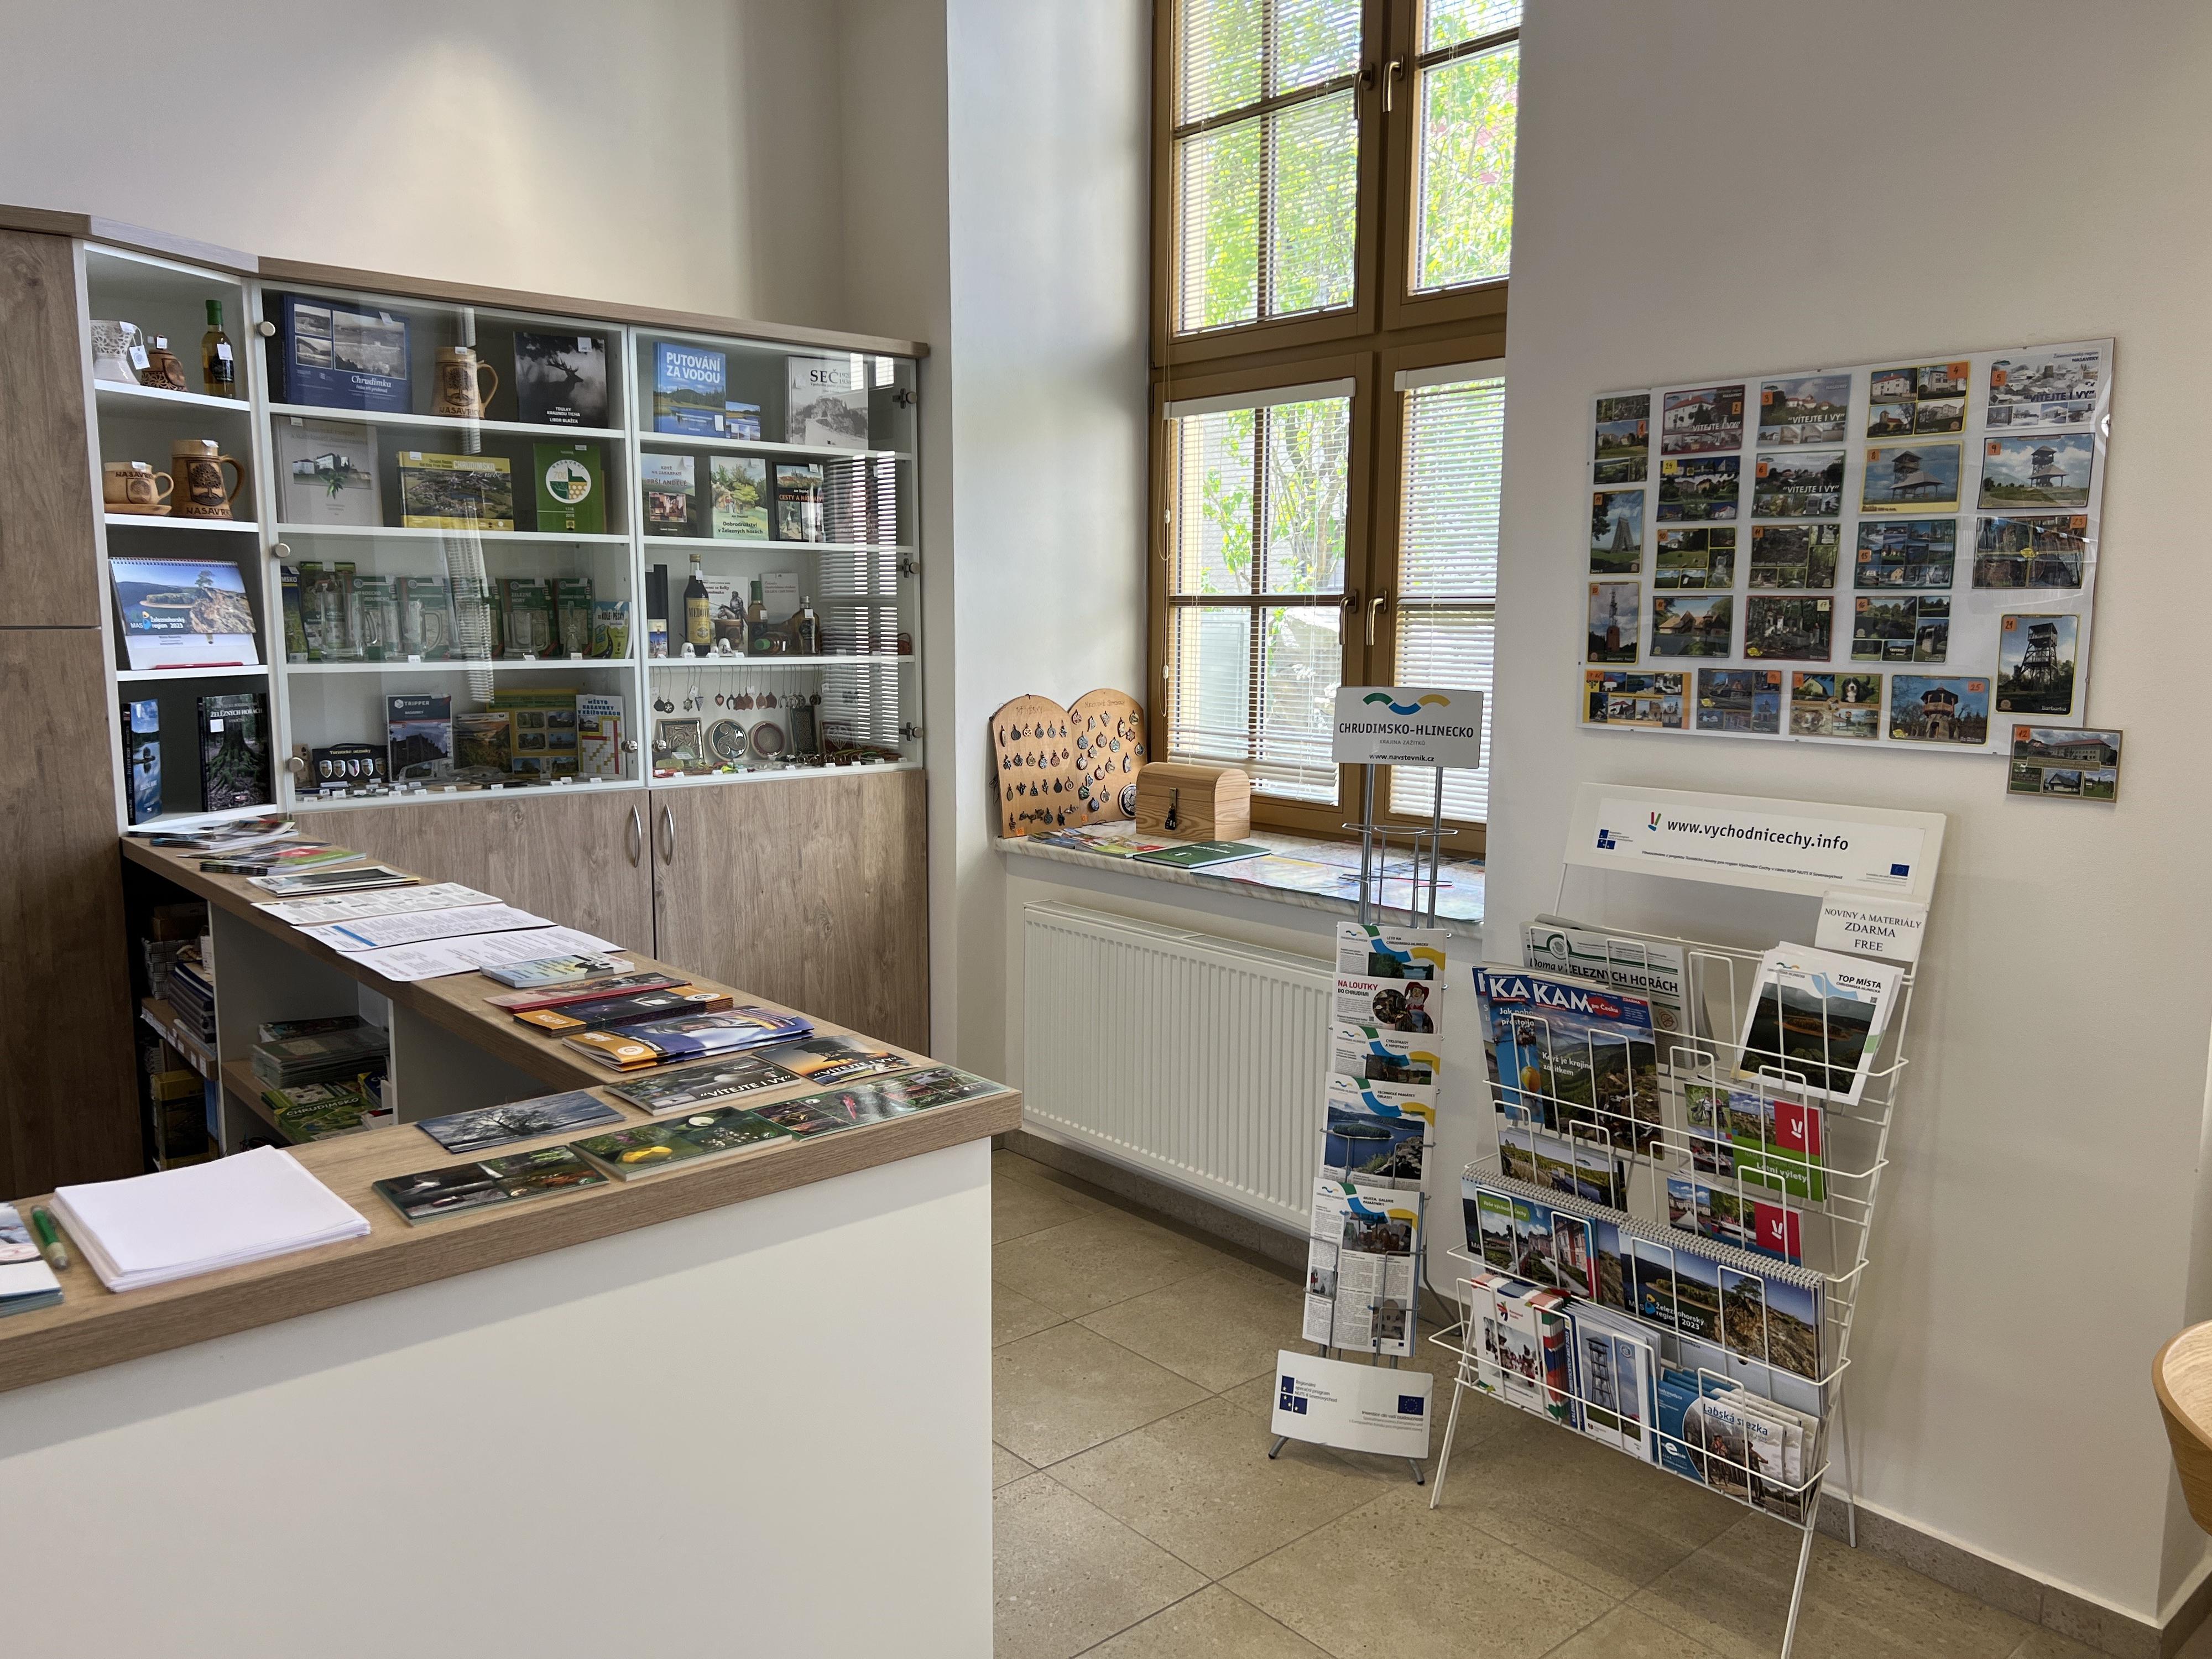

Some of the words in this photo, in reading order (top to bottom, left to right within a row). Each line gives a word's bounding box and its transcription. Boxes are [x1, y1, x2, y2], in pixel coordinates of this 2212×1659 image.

[666, 351, 721, 372] PUTOVÁNÍ
[666, 364, 681, 378] ZA
[682, 367, 721, 384] VODOU
[1953, 365, 1959, 374] 4
[351, 375, 392, 388] Chrudimka
[810, 369, 839, 384] SEČ
[1996, 374, 2002, 382] 5
[1764, 394, 1770, 403] 3
[1733, 404, 1739, 413] 2
[1991, 444, 1997, 453] 9
[453, 460, 496, 472] CHRUDIMSKO
[553, 471, 567, 479] 700
[1339, 723, 1474, 738] CHRUDIMSKO-HLINECKO
[2017, 730, 2028, 739] 12
[1369, 754, 1435, 762] www.navstevnik.cz
[1667, 821, 1849, 851] www.vychodnicechy.info
[1824, 908, 1859, 919] NOVINY
[1868, 914, 1923, 929] MATERIÁLY
[1844, 921, 1896, 938] ZDARMA
[1854, 938, 1884, 952] FREE
[1530, 957, 1556, 971] Doma
[1630, 974, 1678, 993] HORÁCH
[1838, 974, 1855, 984] TOP
[1856, 977, 1881, 989] MÍSTA
[1338, 979, 1348, 988] NA
[1349, 981, 1379, 991] LOUTKY
[1489, 977, 1531, 999] KA
[1532, 983, 1594, 1014] KAM
[1600, 1003, 1619, 1014] Česku
[1499, 1007, 1510, 1015] Jak
[813, 1058, 868, 1077] “VÍTEJTE
[1561, 1056, 1568, 1066] je
[1542, 1064, 1574, 1077] záitkem
[700, 1082, 759, 1098] “VÍTEJTE
[773, 1075, 791, 1084] VY”
[286, 1097, 360, 1116] CHRUDIMSKO
[1780, 1170, 1807, 1183] výlety
[1470, 1241, 1481, 1249] MA
[1628, 1300, 1645, 1311] MS
[1656, 1311, 1677, 1321] region
[1682, 1318, 1700, 1330] 2023
[1312, 1388, 1331, 1396] program
[1703, 1403, 1735, 1423] Labská
